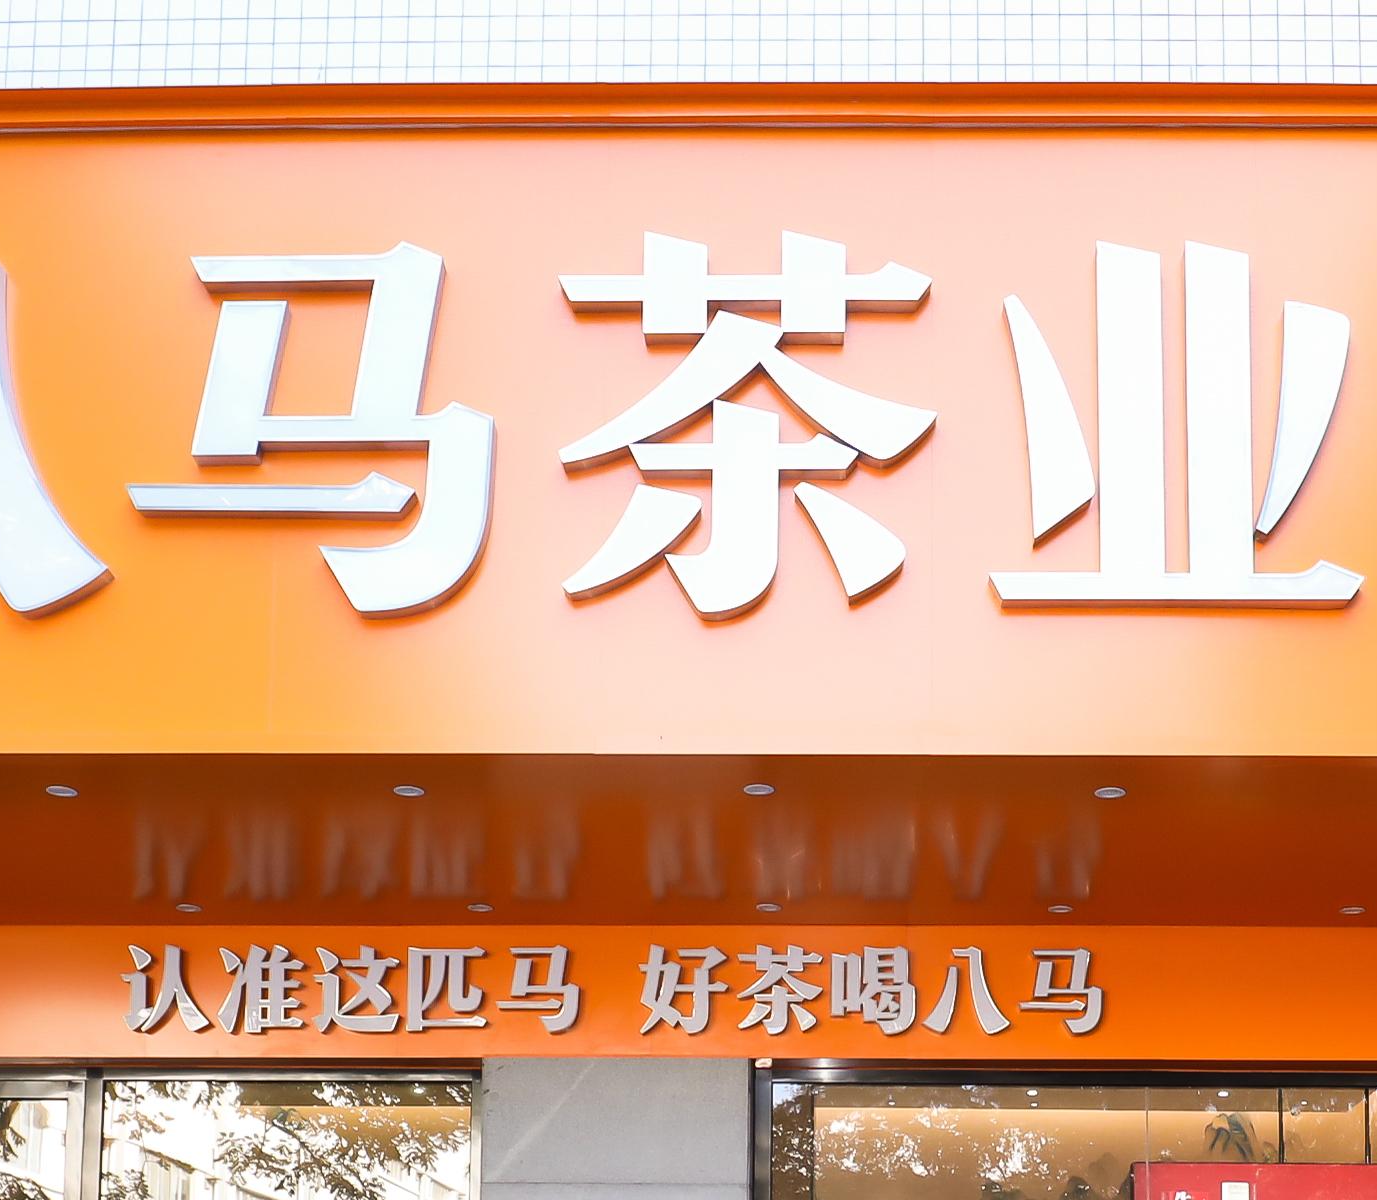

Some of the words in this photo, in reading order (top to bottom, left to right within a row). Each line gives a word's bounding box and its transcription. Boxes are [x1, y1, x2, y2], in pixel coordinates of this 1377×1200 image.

[121, 944, 581, 1036] 认准这匹马
[638, 944, 1105, 1036] 好茶喝八马
